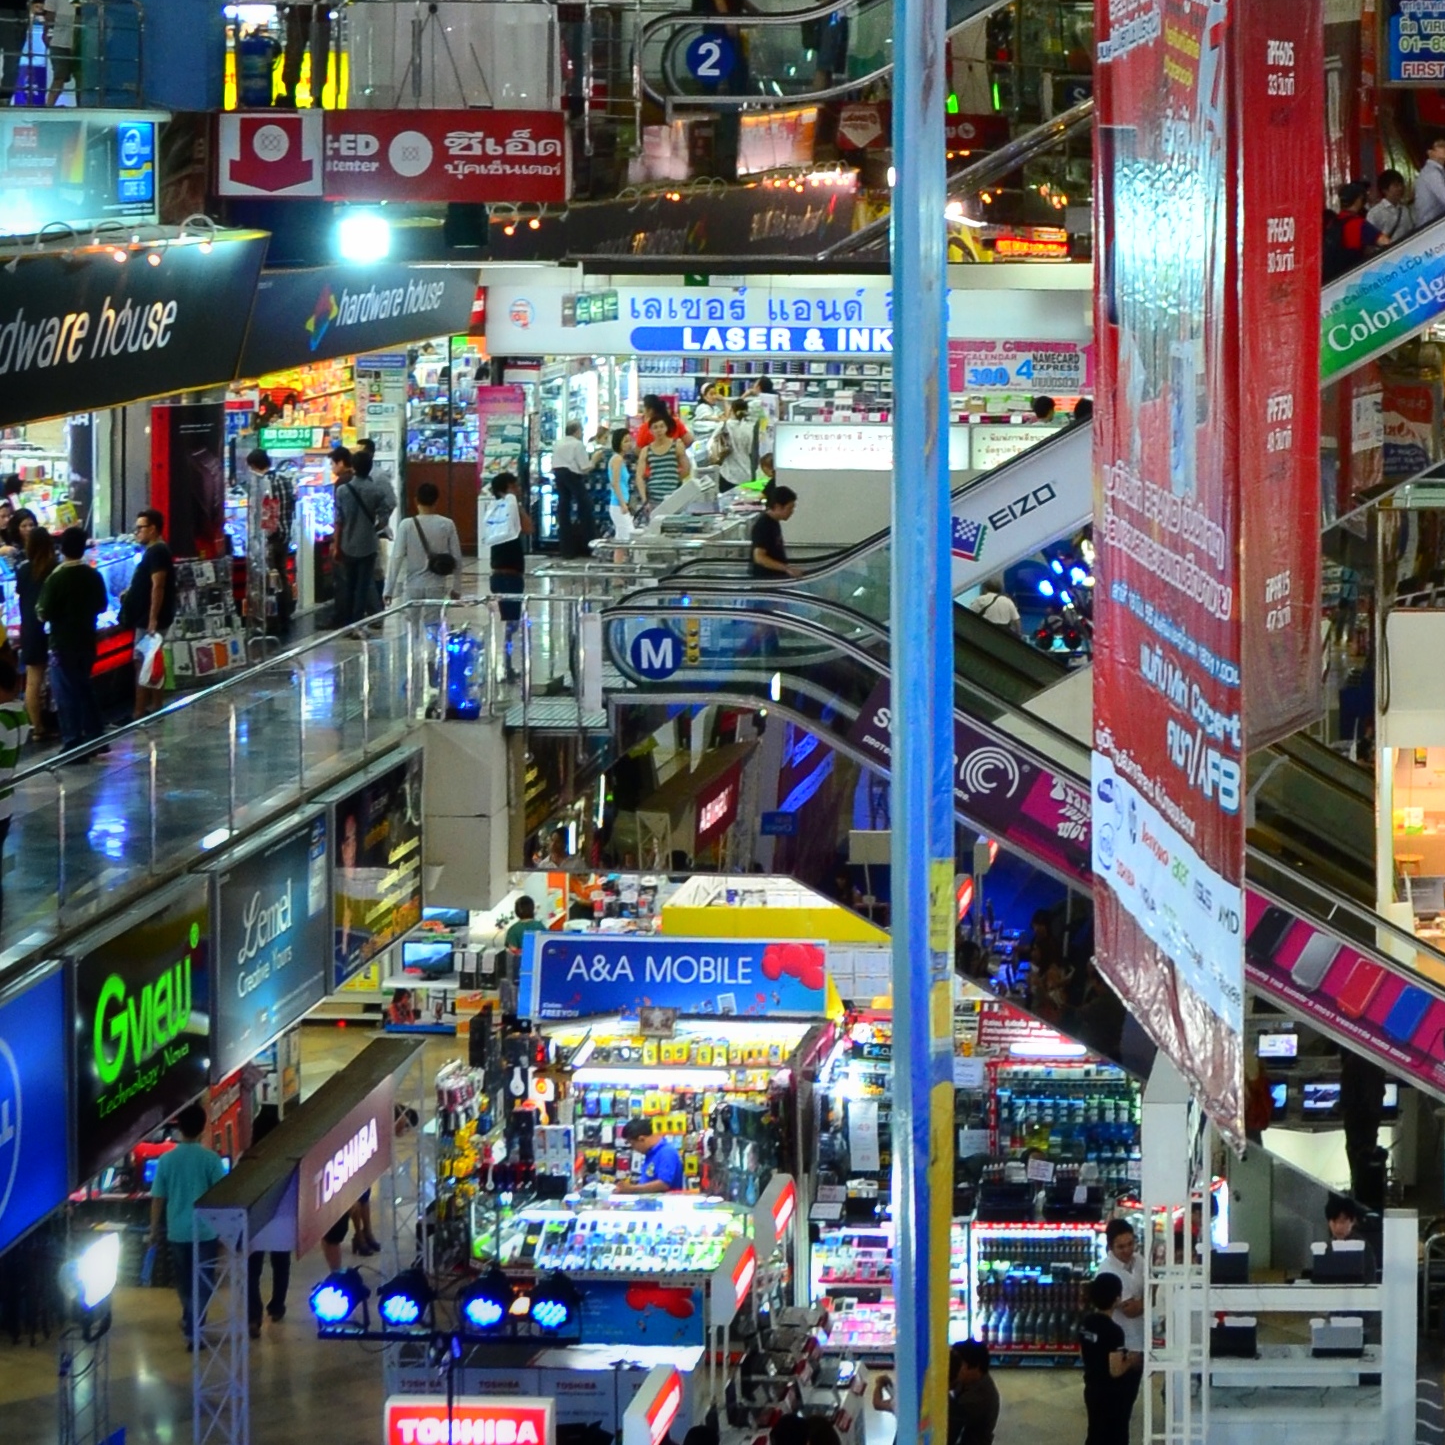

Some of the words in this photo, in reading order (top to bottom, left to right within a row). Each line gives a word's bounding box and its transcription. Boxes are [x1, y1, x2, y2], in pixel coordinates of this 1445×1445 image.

[696, 41, 721, 77] 2
[444, 128, 563, 158] ซีเอ็ด
[1341, 269, 1399, 307] Calibration
[1397, 256, 1425, 278] LCD
[335, 285, 405, 328] hardware
[401, 276, 446, 317] house
[630, 284, 748, 322] เลเซอร์
[767, 286, 866, 323] แอนด์
[90, 295, 179, 359] house
[682, 325, 793, 353] LASER
[803, 325, 826, 353] &
[835, 325, 893, 353] INK
[1032, 352, 1081, 365] NAMECARD
[1032, 364, 1081, 373] EXPRESS
[987, 482, 1057, 532] EIZO
[639, 637, 674, 670] M
[237, 877, 293, 965] Lemel
[566, 954, 635, 986] A&A
[643, 955, 753, 986] MOBILE
[96, 1067, 160, 1120] Technology
[313, 1117, 379, 1213] TOSHIBA
[397, 1418, 540, 1445] TOSHIBA
